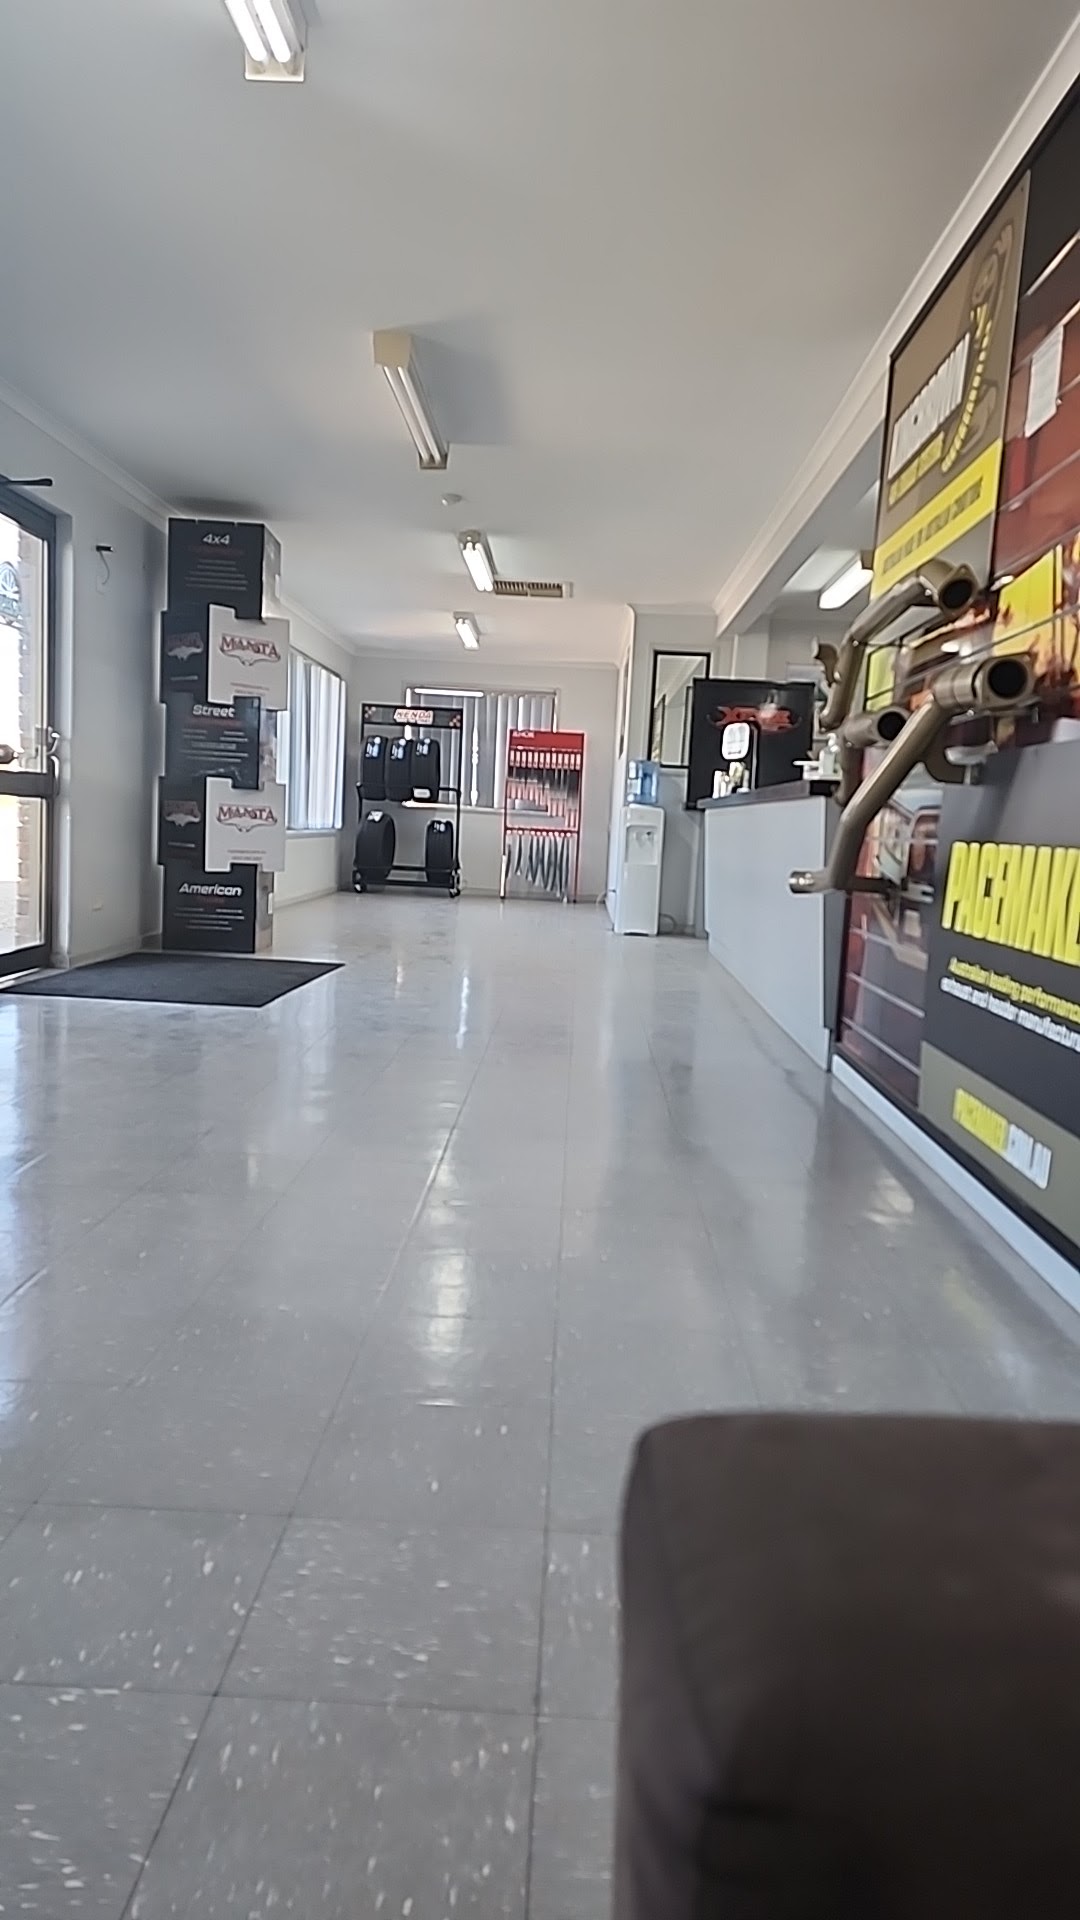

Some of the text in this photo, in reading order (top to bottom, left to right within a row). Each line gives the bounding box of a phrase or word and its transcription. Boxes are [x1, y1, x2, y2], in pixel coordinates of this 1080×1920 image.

[203, 533, 230, 545] 4x4
[192, 704, 236, 718] Street
[179, 883, 243, 897] American
